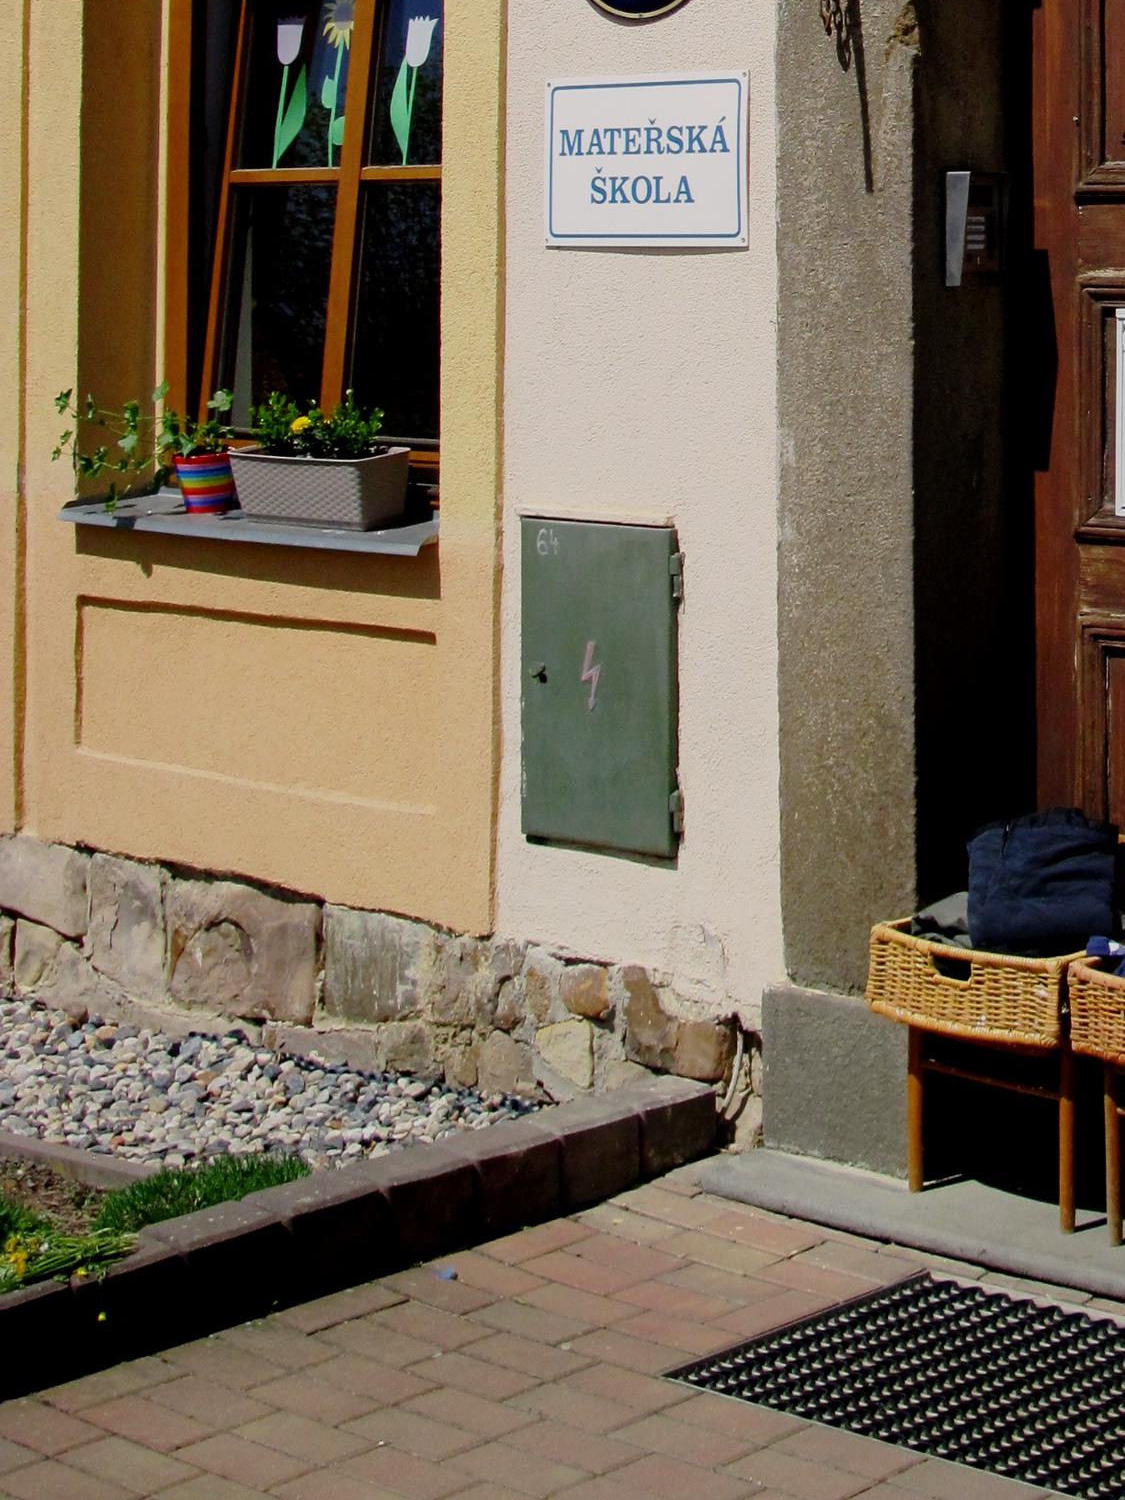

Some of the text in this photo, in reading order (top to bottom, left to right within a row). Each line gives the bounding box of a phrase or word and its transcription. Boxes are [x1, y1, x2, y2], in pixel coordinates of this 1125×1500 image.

[559, 116, 730, 156] MATEŘSKÁ
[591, 167, 695, 204] ŠKOLA
[536, 528, 560, 555] 64
